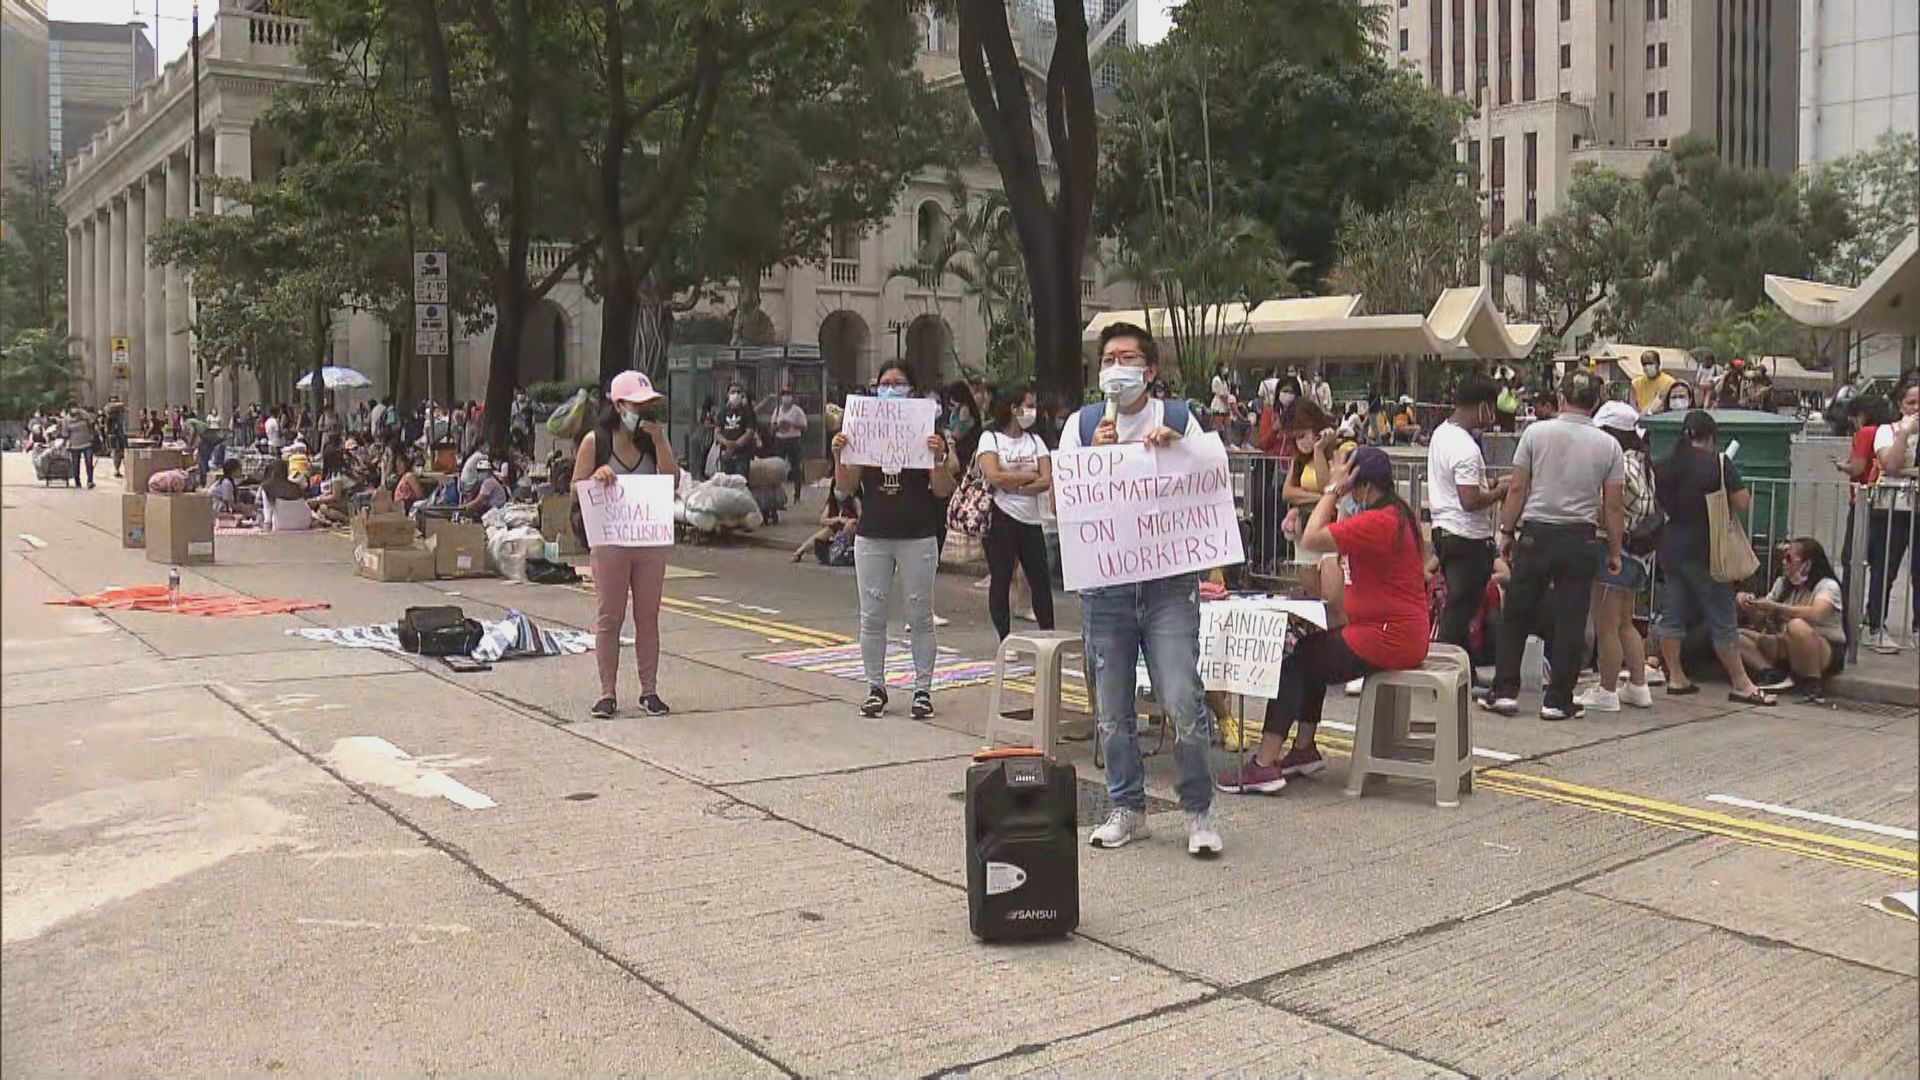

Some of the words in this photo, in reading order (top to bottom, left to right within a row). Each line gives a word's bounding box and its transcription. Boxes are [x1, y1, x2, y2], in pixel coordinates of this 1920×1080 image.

[848, 400, 869, 418] WE
[876, 401, 906, 421] ARE
[847, 438, 866, 454] WE
[887, 440, 910, 454] ARE
[1057, 450, 1124, 482] STOP
[588, 484, 624, 507] END
[1062, 464, 1228, 508] STIGMATIZATION
[604, 503, 656, 522] SOCIAL
[1079, 517, 1116, 544] ON
[1137, 503, 1223, 540] MIGRANT
[602, 523, 673, 541] EXCLUSION
[1097, 529, 1229, 579] WORKERS!
[1202, 610, 1285, 638] RAINING
[1225, 636, 1283, 664] REFUND
[1018, 909, 1057, 920] SANSUI
